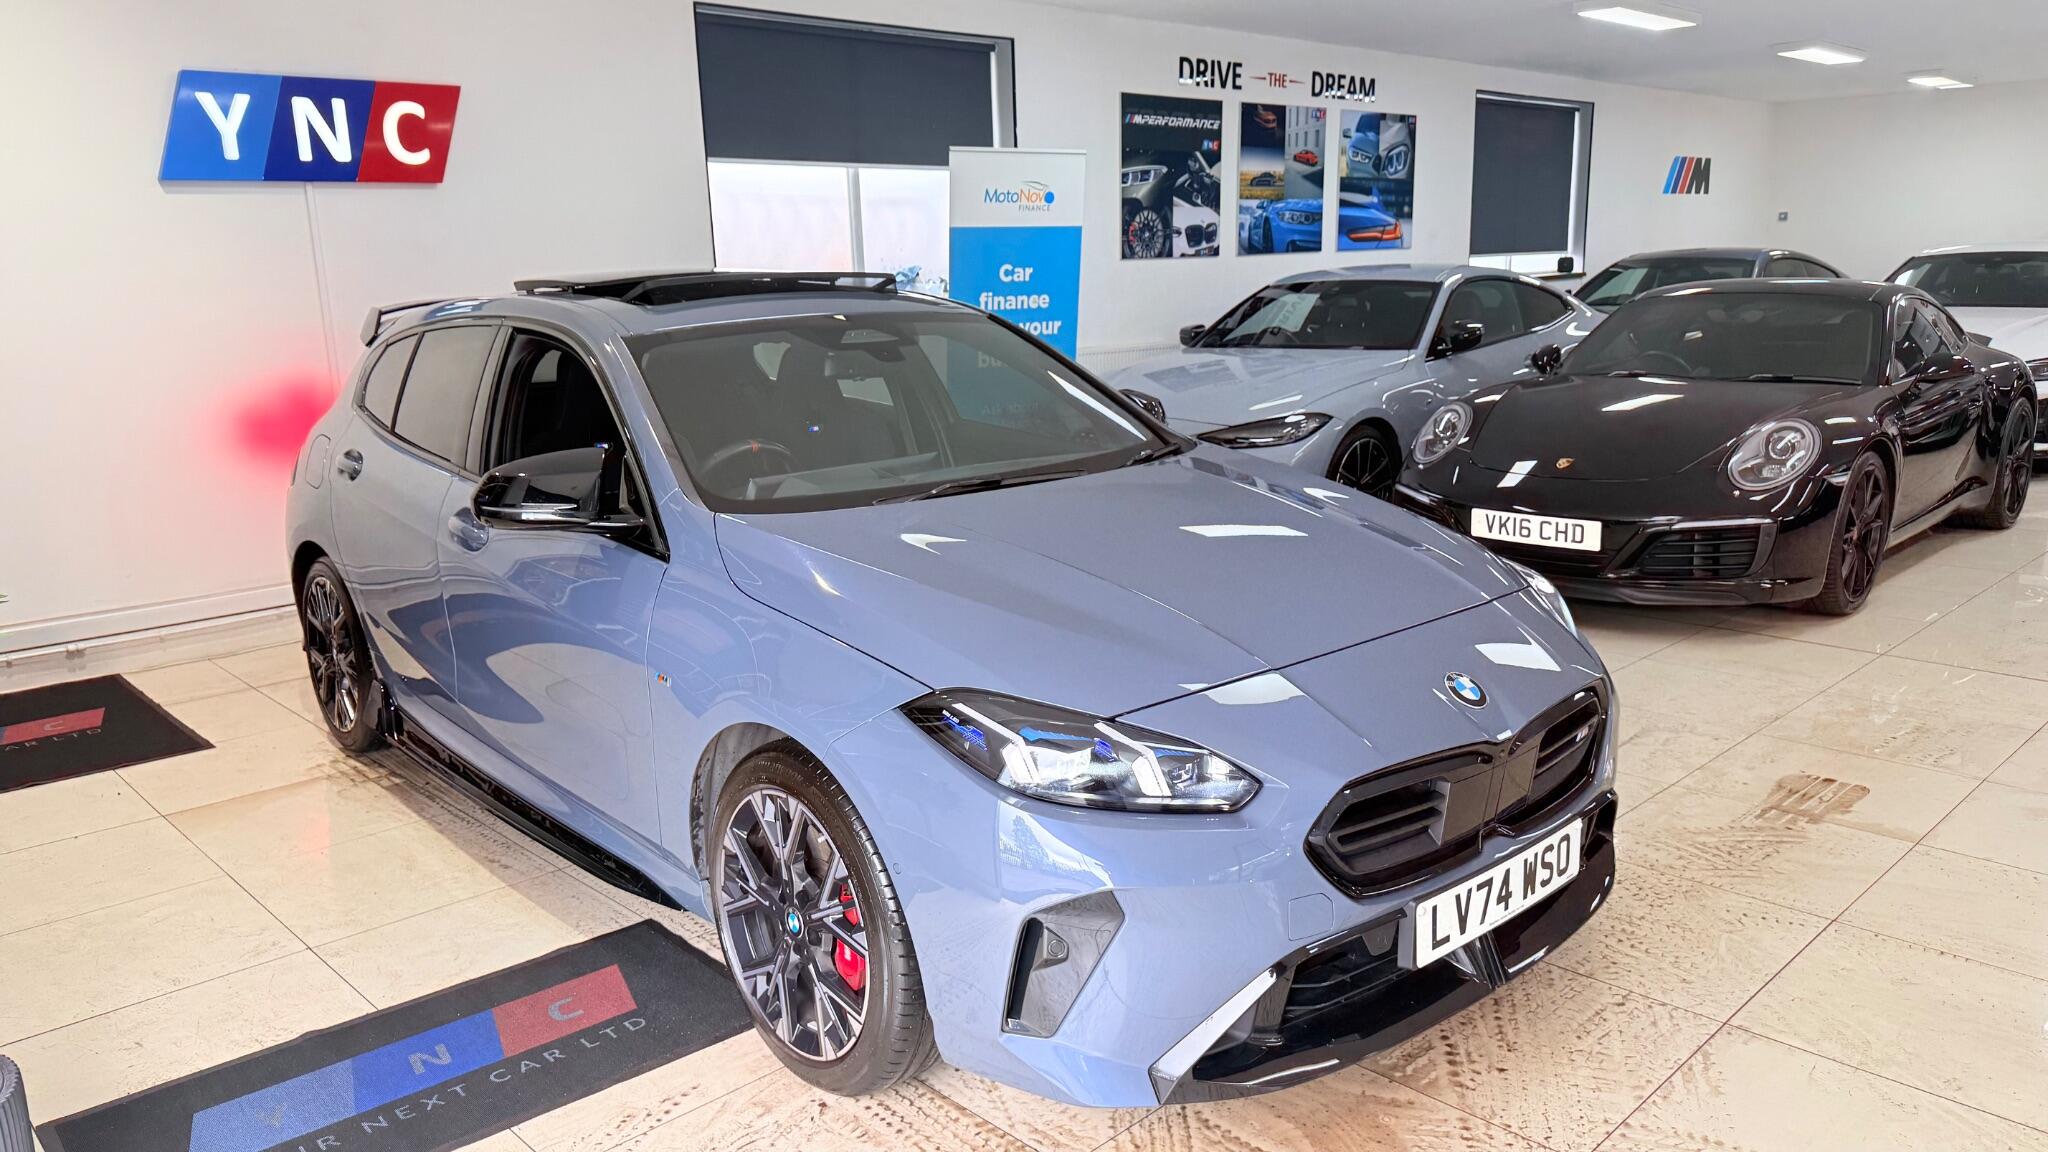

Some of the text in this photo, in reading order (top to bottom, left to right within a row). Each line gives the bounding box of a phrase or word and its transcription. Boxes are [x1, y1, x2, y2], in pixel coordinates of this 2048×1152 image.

[1178, 56, 1376, 103] DRIVE THE DREAM
[1018, 204, 1051, 212] FINANCE
[999, 263, 1034, 283] Car
[979, 291, 1050, 311] finance
[1485, 513, 1585, 544] VK16 CHD
[52, 728, 102, 742] LTD
[1430, 867, 1513, 951] LV74
[360, 1083, 467, 1134] NEXT
[488, 1048, 566, 1083] CAR
[579, 1017, 647, 1049] LTD
